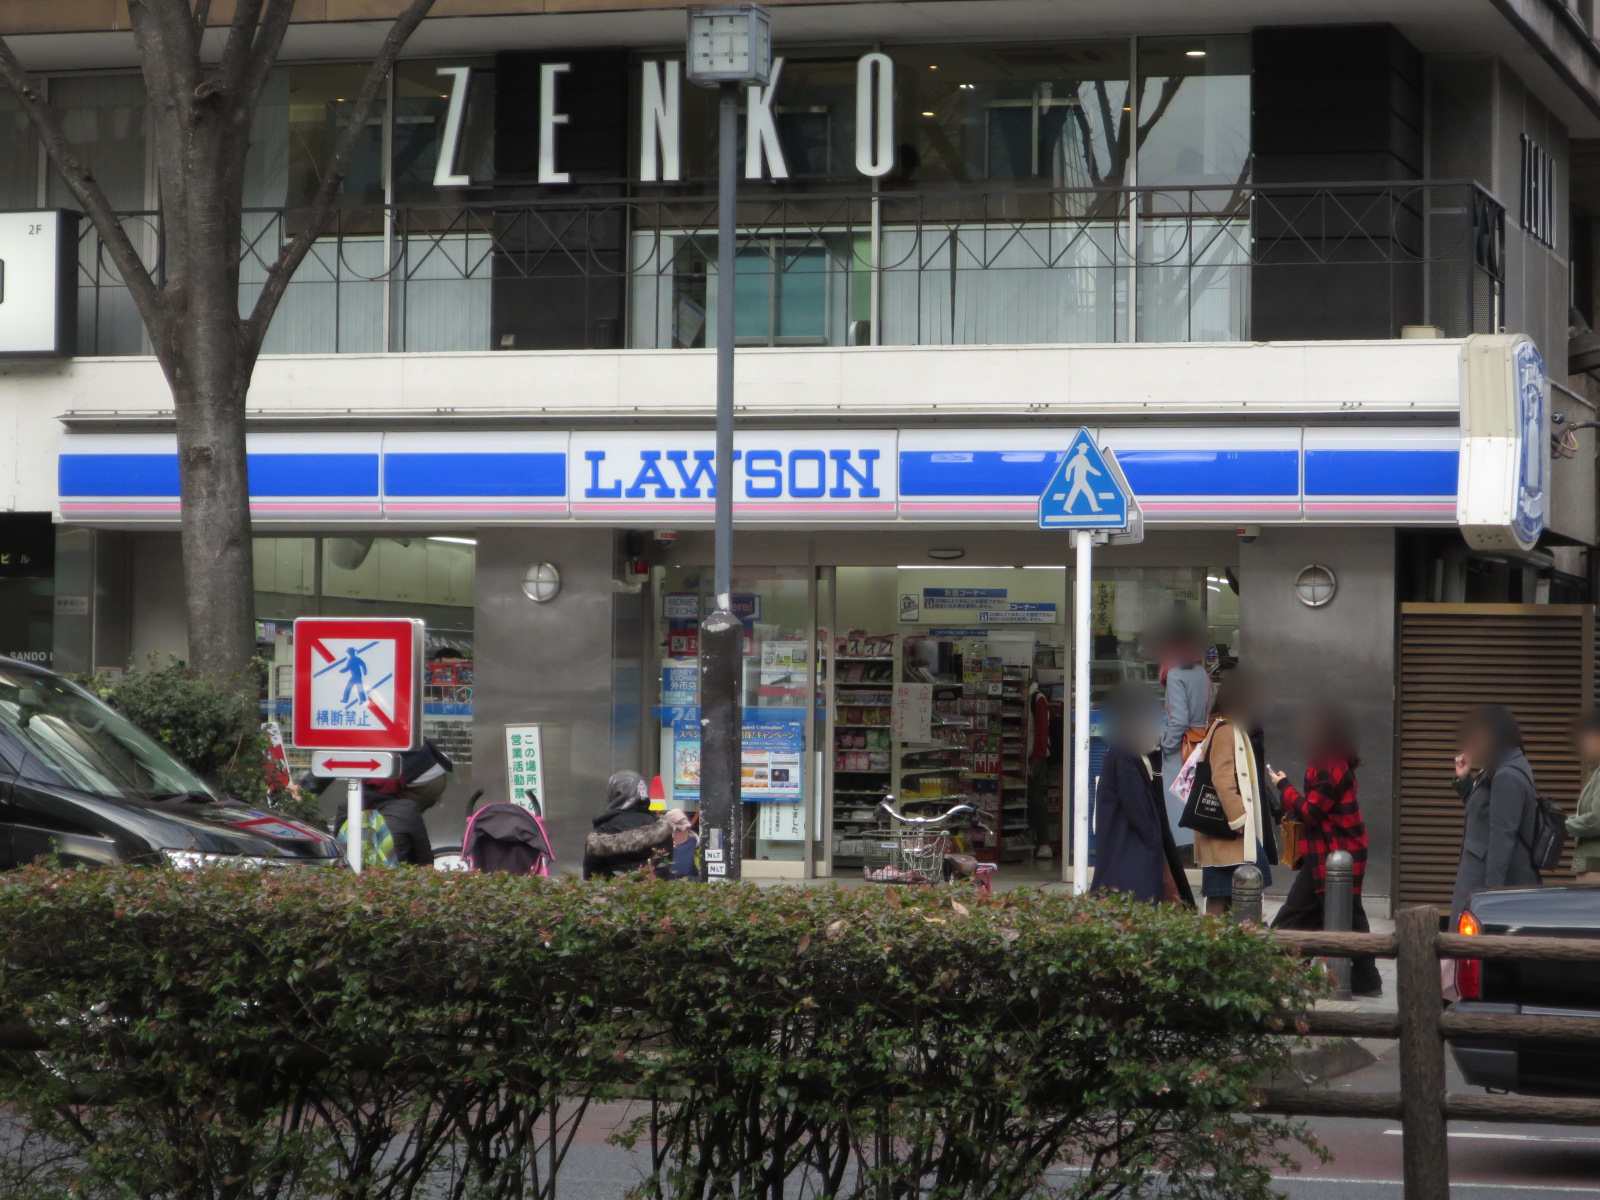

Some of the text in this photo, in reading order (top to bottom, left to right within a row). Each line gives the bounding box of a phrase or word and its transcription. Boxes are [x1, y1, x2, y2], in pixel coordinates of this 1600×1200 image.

[433, 52, 895, 187] ZENKO
[28, 224, 43, 235] 2F
[584, 448, 881, 498] LAWSON
[730, 602, 753, 612] ere!
[9, 651, 47, 662] SANDO
[669, 668, 693, 676] MONEY
[315, 709, 371, 727] 横断禁止
[707, 851, 721, 859] NLT
